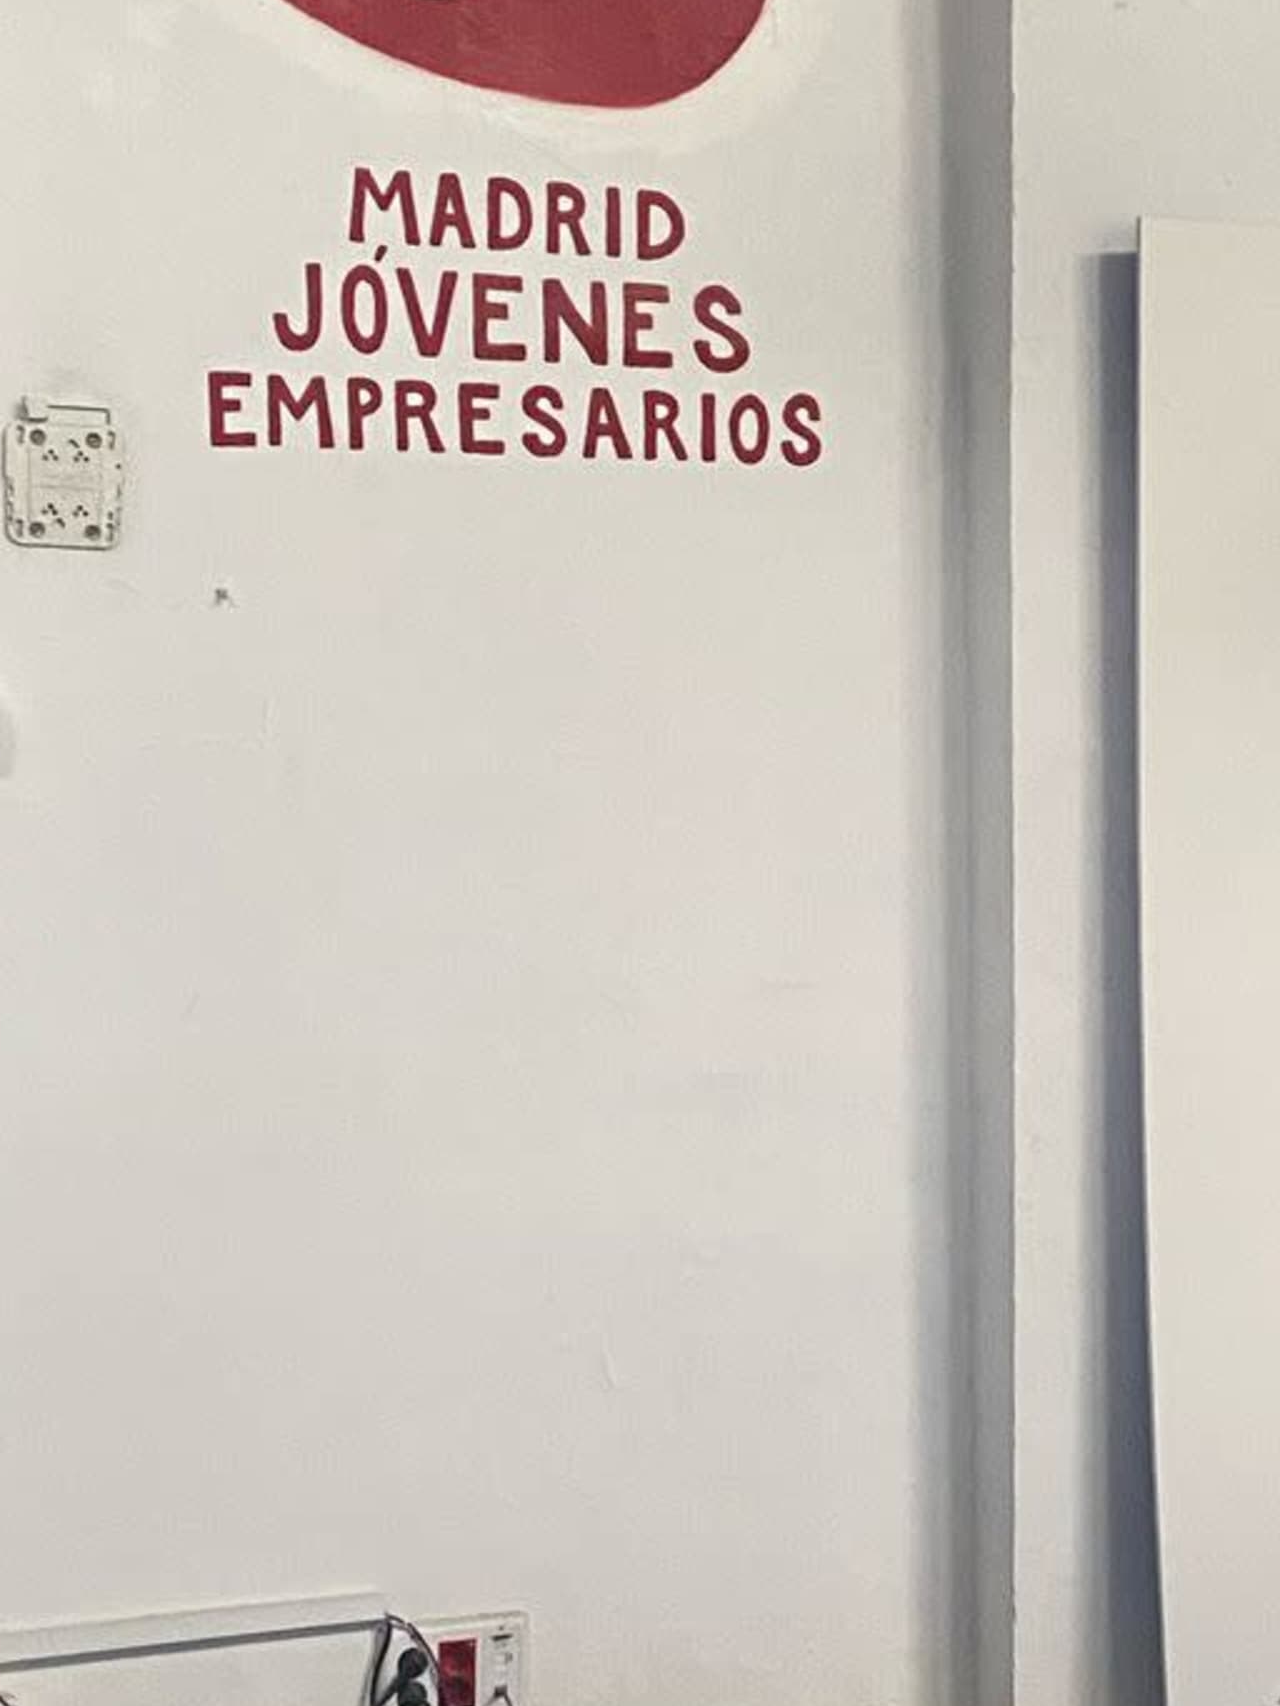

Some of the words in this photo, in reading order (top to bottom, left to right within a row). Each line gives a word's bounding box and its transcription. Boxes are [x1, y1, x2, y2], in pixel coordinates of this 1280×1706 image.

[349, 167, 685, 260] MADRID
[274, 244, 750, 374] JÓVENES
[207, 372, 822, 467] EMPRESARIOS
